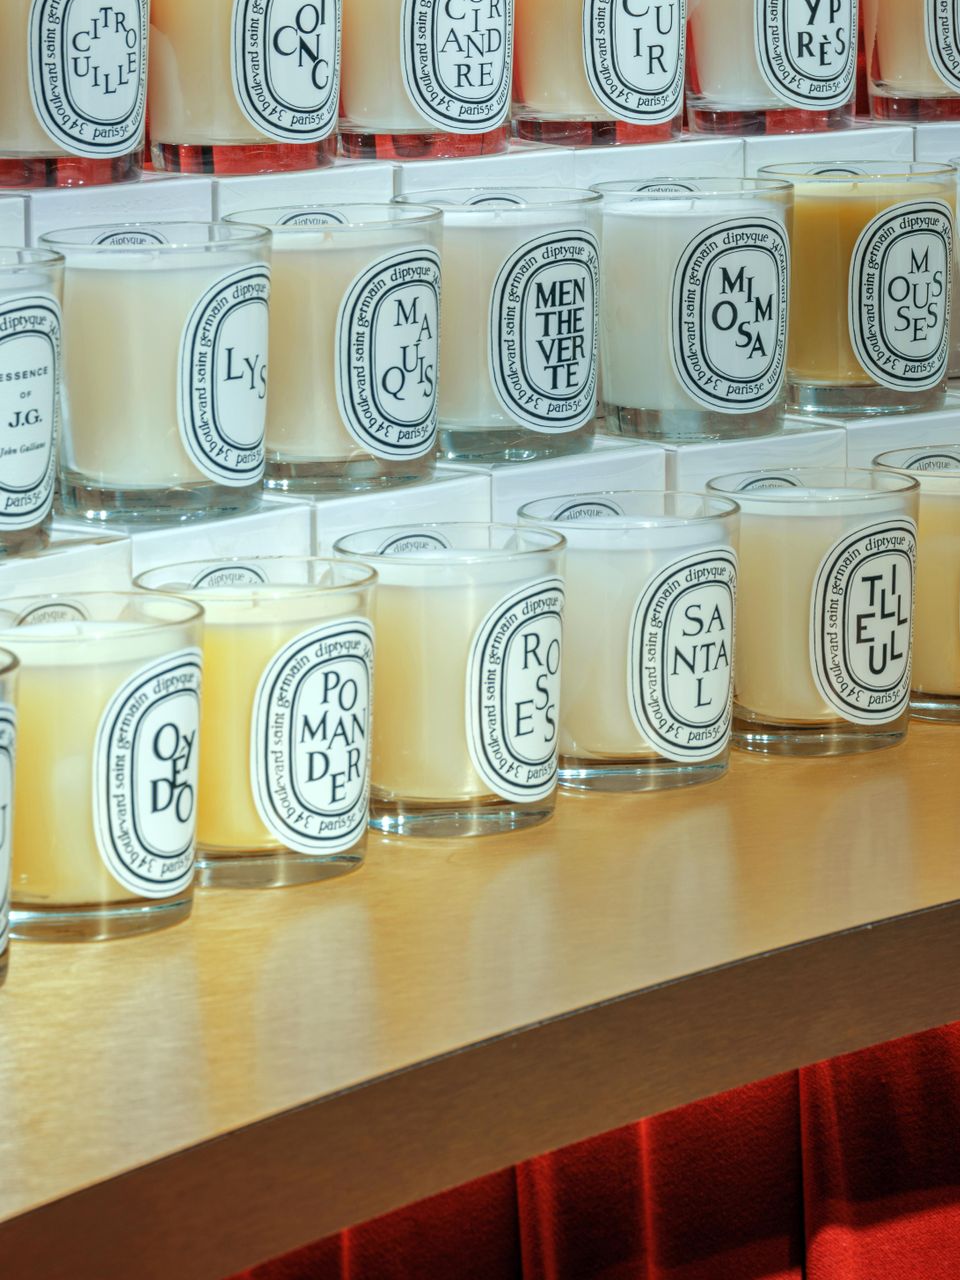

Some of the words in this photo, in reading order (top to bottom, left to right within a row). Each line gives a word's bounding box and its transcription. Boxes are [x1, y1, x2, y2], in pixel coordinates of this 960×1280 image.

[899, 215, 940, 230] diptyque
[722, 230, 769, 246] diptyque
[541, 244, 585, 259] diptyque
[389, 265, 432, 282] diptyque
[535, 277, 586, 310] MEN
[535, 308, 585, 338] THE
[536, 334, 586, 365] VER
[543, 361, 579, 391] TE
[19, 390, 32, 399] OF
[8, 409, 43, 428] J.G.
[864, 535, 906, 552] diptyque
[684, 566, 727, 583] diptyque
[522, 597, 559, 616] diptyque
[315, 638, 362, 658] diptyque
